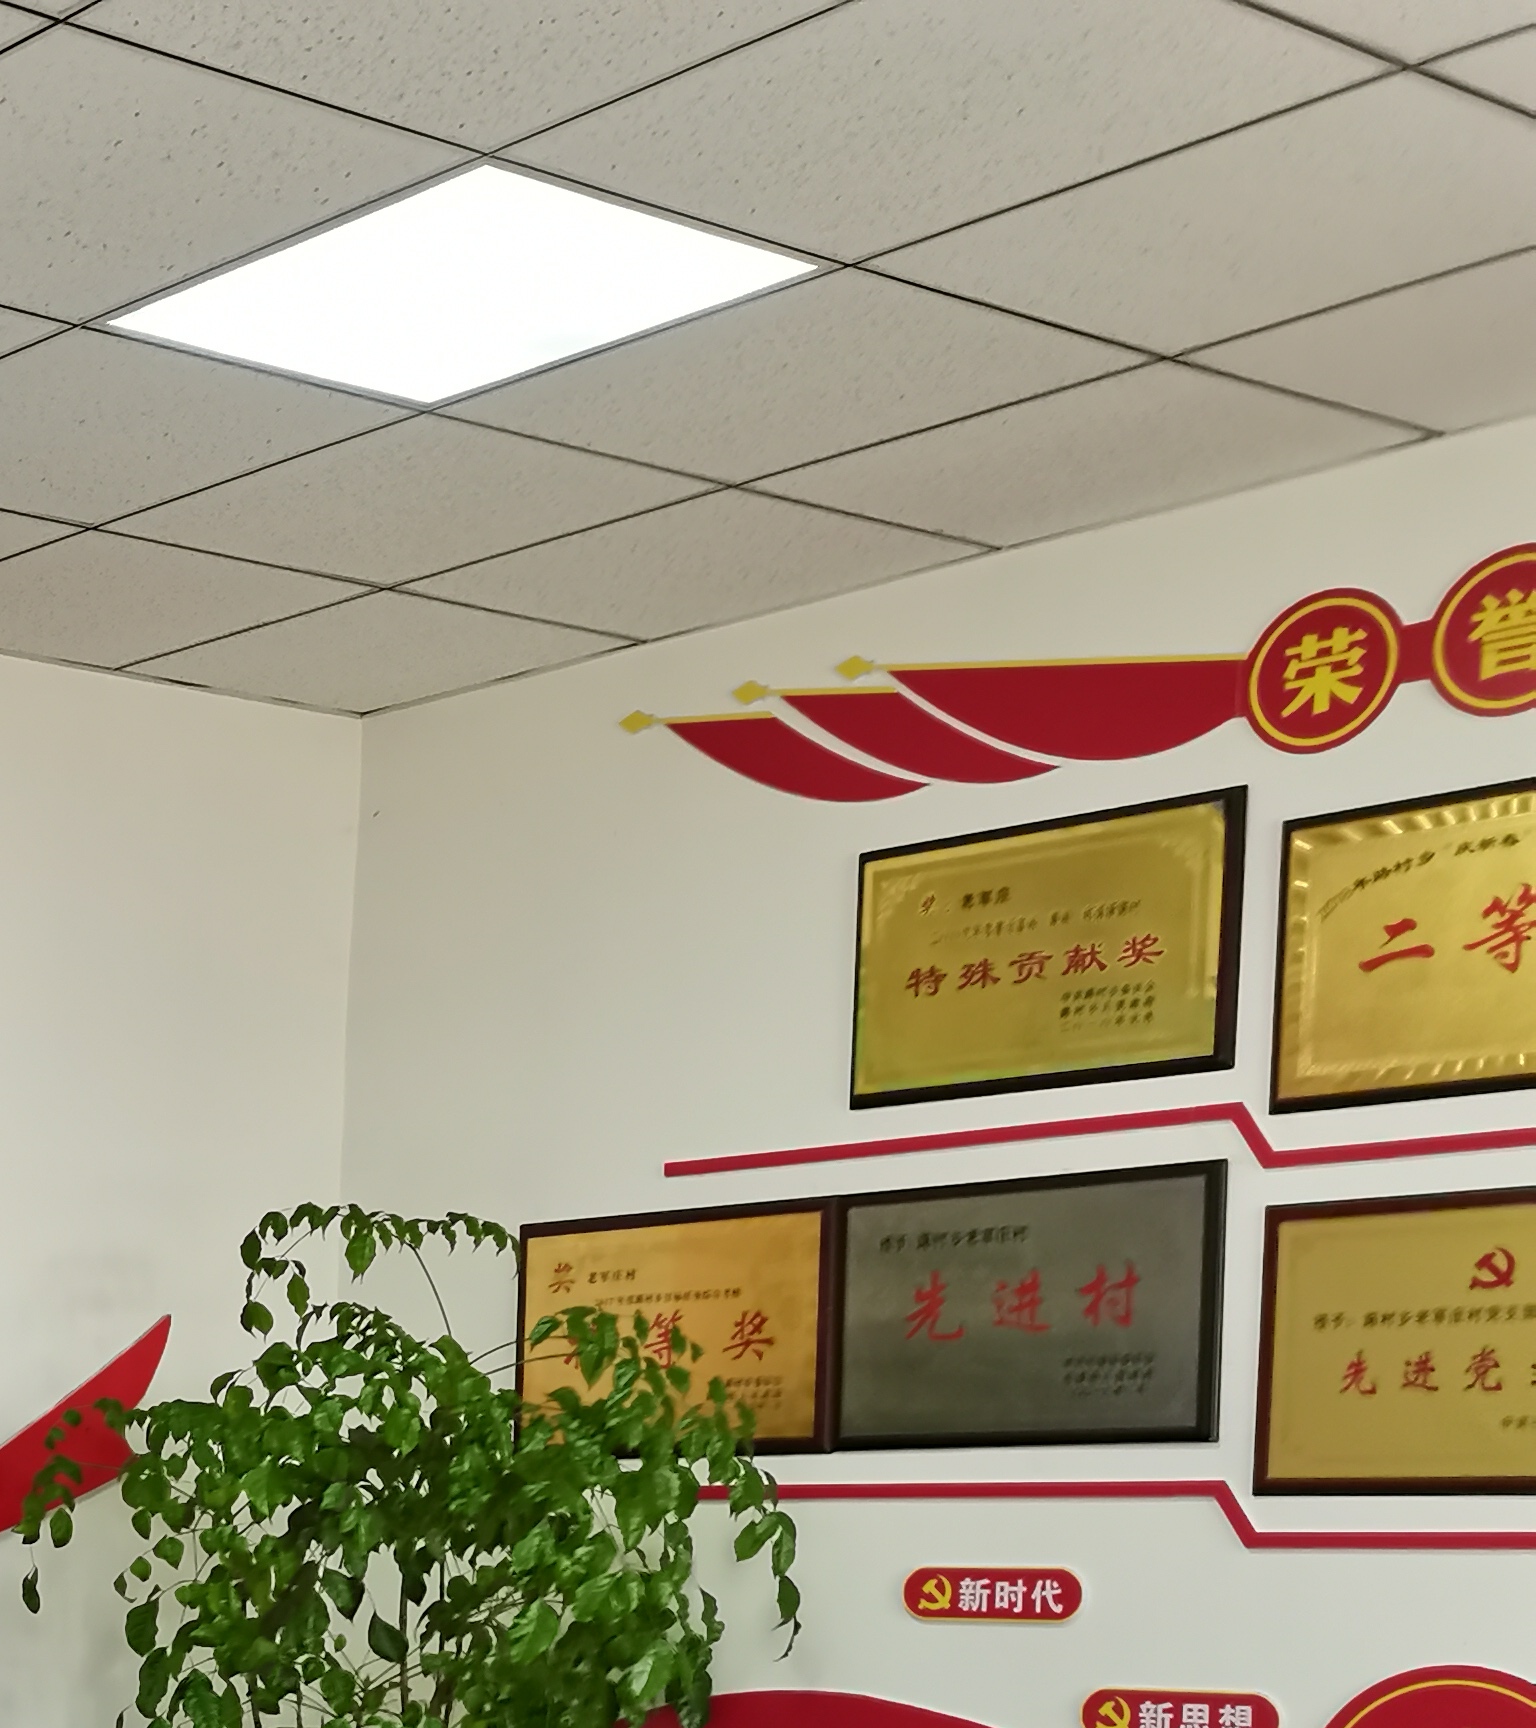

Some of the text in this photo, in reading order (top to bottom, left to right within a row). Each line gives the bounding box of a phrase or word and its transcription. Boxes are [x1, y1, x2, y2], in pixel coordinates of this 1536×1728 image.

[1281, 586, 1536, 720] 荣誉
[905, 933, 1165, 999] 特殊贡献奖
[905, 1258, 1141, 1341] 先进村
[1339, 1345, 1536, 1396] 先进党
[957, 1576, 1064, 1615] 新时代
